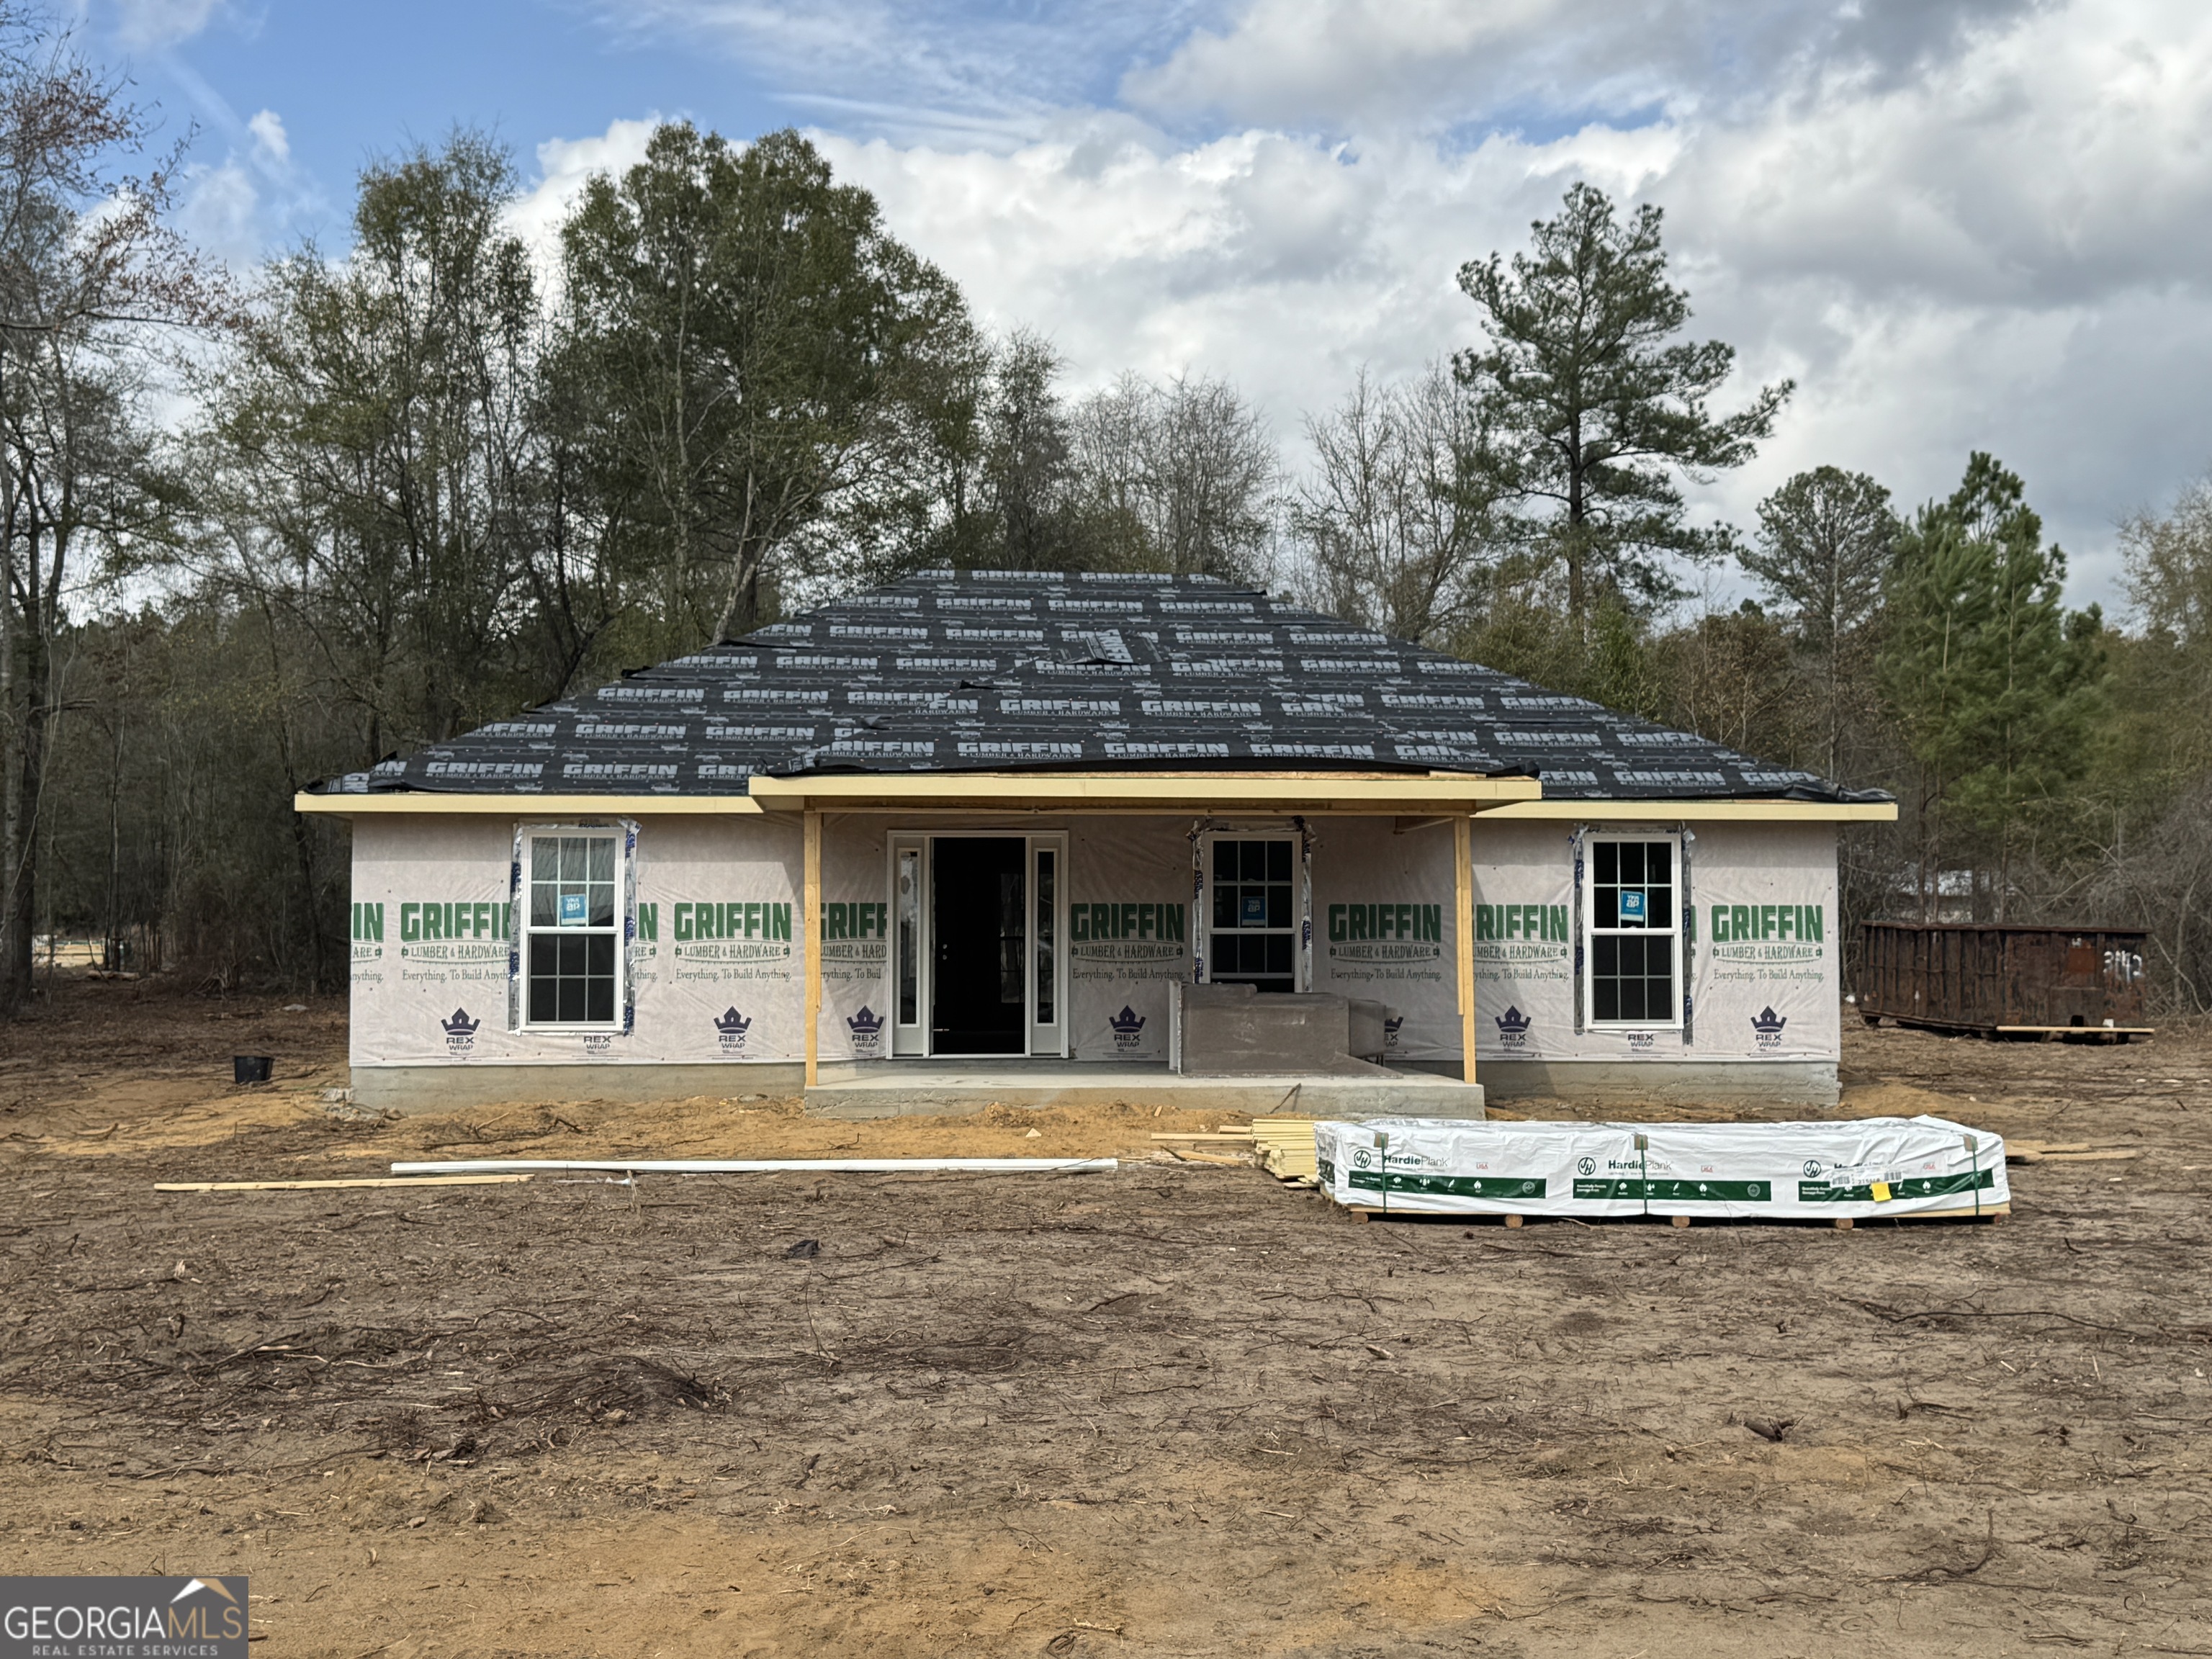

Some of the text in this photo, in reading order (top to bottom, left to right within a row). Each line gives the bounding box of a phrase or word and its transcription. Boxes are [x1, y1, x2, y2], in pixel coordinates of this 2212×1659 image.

[830, 626, 927, 635] GRIFFIN
[945, 629, 1043, 638] GRIFFIN
[1176, 632, 1273, 641] GRIFFIN
[776, 657, 878, 665] GRIFFIN
[896, 658, 997, 667] GRIFFIN
[1300, 660, 1401, 670] GRIFFIN
[598, 688, 704, 698] GRIFFIN
[724, 691, 828, 700] GRIFFIN
[1000, 699, 1120, 711] GRIFFIN
[1381, 694, 1484, 705] GRIFFIN
[1141, 701, 1262, 711] GRIFFIN
[576, 724, 686, 734] GRIFFIN
[706, 727, 814, 736] GRIFFIN
[1494, 732, 1601, 742] GRIFFIN
[958, 742, 1082, 753] GRIFFIN
[1104, 743, 1229, 753] GRIFFIN
[1250, 744, 1375, 755] GRIFFIN
[426, 762, 544, 773] GRIFFIN
[563, 764, 678, 774] GRIFFIN
[1614, 771, 1725, 782] GRIFFIN
[675, 902, 791, 942] GRIFFIN
[821, 902, 887, 940] RIFF
[1071, 903, 1184, 942] GRIFFIN
[1328, 904, 1442, 943] GRIFFIN
[1473, 904, 1568, 943] RIFFIN
[1712, 905, 1823, 943] GRIFFIN
[411, 946, 448, 959] LUMBER
[458, 945, 509, 959] HARDWARE
[685, 945, 720, 958] LUMBER
[729, 944, 781, 958] HARDWARE
[862, 944, 887, 958] HARD
[1081, 945, 1115, 958] LUMBER
[1124, 944, 1174, 958] HARDWARE
[1339, 945, 1373, 959] LUMBER
[1382, 945, 1431, 959] HARDWARE
[1473, 946, 1500, 959] UMBER
[1509, 945, 1557, 959] HARDWARE
[1722, 946, 1755, 959] LUMBER
[1764, 945, 1813, 959] HARDWARE
[449, 969, 460, 979] To
[462, 968, 482, 979] Build
[721, 968, 732, 979] To
[734, 968, 752, 979] Build
[855, 968, 864, 979] To
[1117, 968, 1127, 979] To
[1128, 968, 1147, 979] Build
[1375, 968, 1385, 979] To
[1386, 968, 1405, 979] Build
[1501, 969, 1511, 979] To
[1514, 968, 1532, 979] Build
[1758, 969, 1768, 979] To
[1768, 968, 1787, 979] Build
